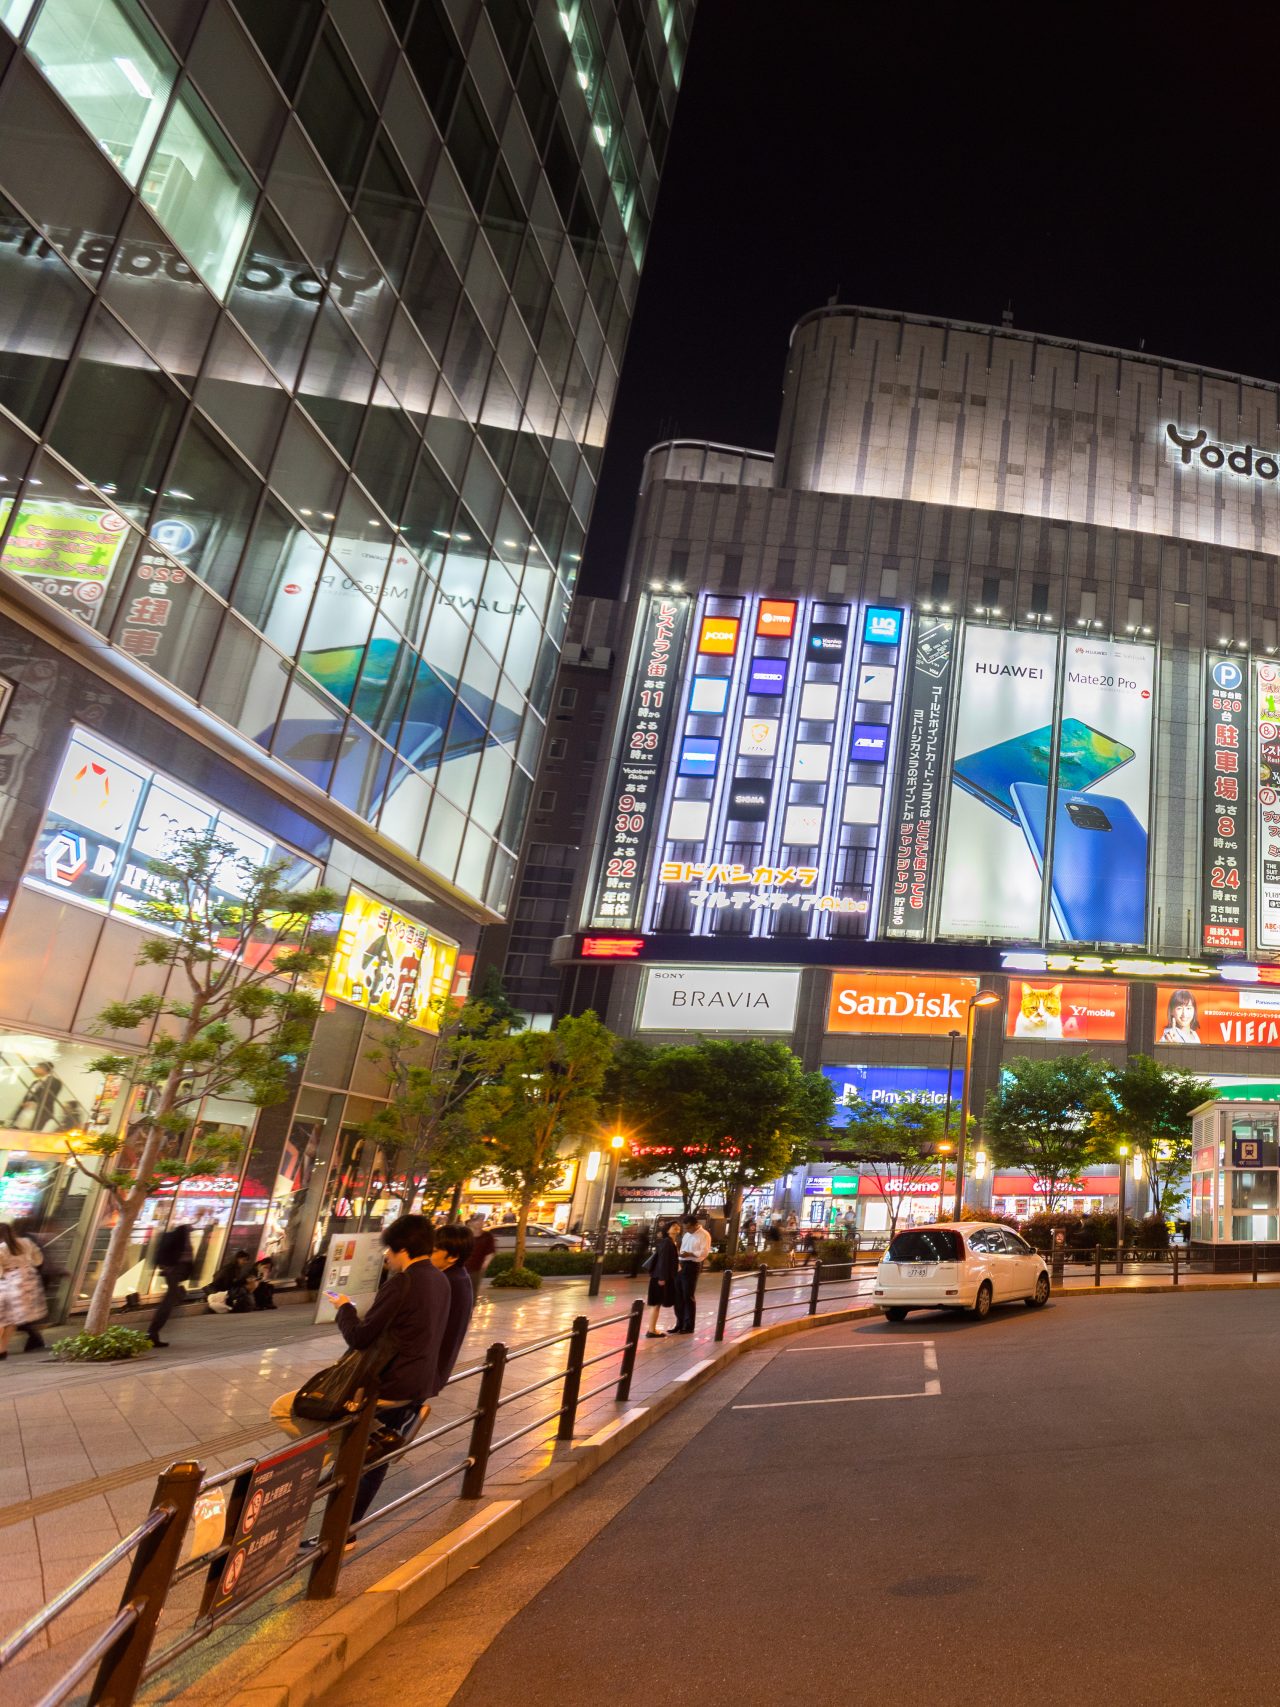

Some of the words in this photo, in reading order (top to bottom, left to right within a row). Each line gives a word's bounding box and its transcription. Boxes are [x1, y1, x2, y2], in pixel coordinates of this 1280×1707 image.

[648, 601, 677, 677] レストラン街
[975, 662, 1044, 680] HUAWEI
[1117, 677, 1137, 689] Pro
[640, 690, 664, 707] 11
[1212, 698, 1242, 712] 520
[636, 721, 658, 730] よる
[1221, 712, 1232, 722] 台
[630, 731, 658, 749] 23
[903, 709, 924, 821] ヨドバシカメラのポイントが
[1215, 723, 1239, 800] 駐車場
[625, 783, 647, 792] あさ
[1215, 804, 1238, 815] あさ
[614, 814, 644, 832] 30
[1218, 816, 1235, 837] 8
[613, 847, 636, 857] よる
[1213, 837, 1238, 849] 時から
[606, 858, 637, 877] 22
[894, 822, 914, 895] ジャンジャン
[909, 820, 931, 909] どこで使っても
[1214, 856, 1237, 867] よる
[660, 862, 819, 887] ヨドバシカメラ
[1211, 867, 1240, 889] 24
[1212, 890, 1238, 901] 時まで
[672, 990, 770, 1009] BRAVIA
[838, 989, 963, 1018] SanDisk
[1220, 1020, 1278, 1044] VIERA
